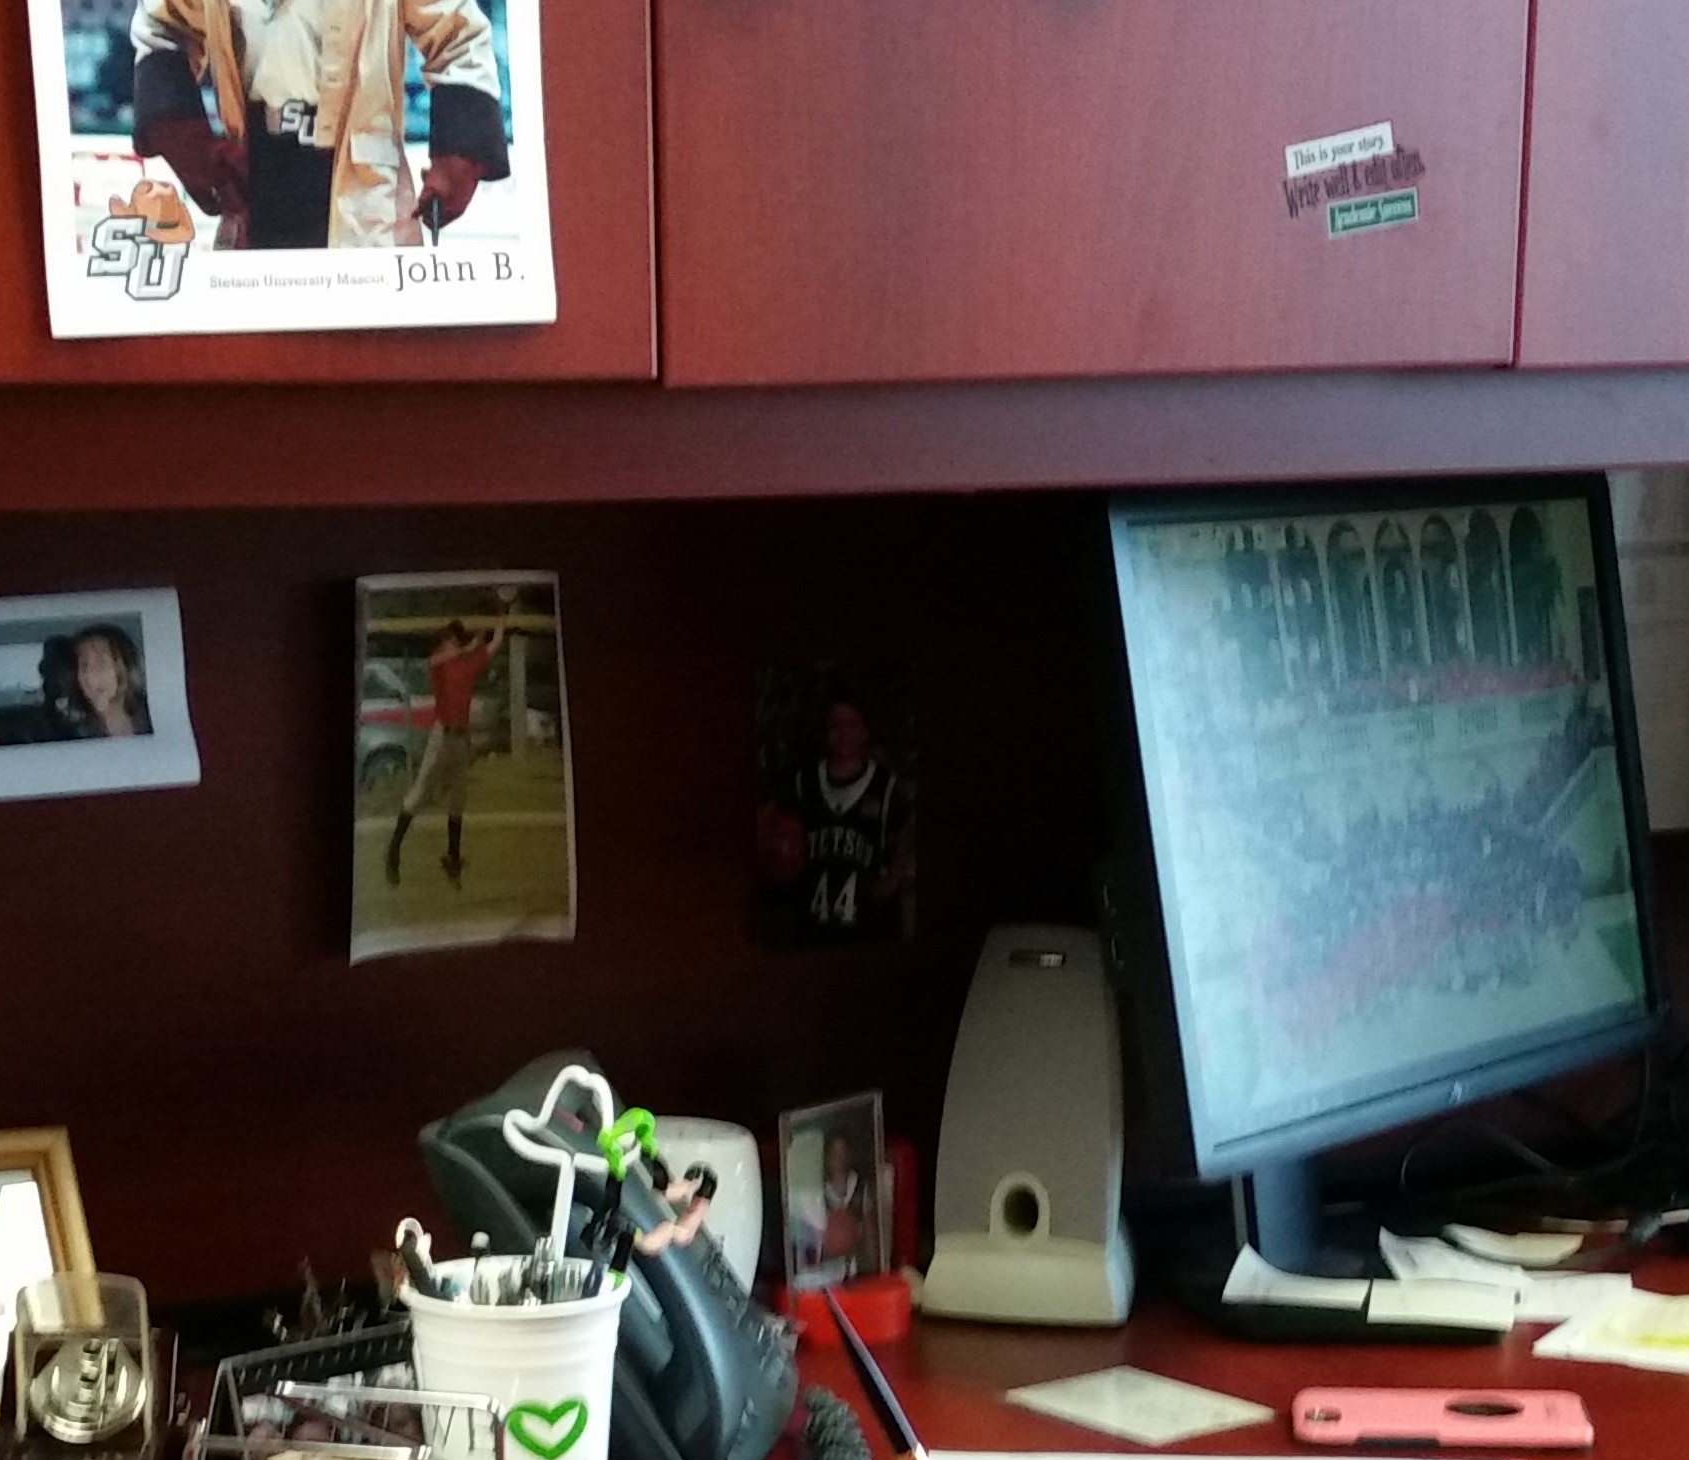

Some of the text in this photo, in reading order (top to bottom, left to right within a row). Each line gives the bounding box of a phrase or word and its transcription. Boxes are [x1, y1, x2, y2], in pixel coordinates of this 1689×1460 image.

[1294, 147, 1316, 170] This
[1319, 144, 1329, 161] is
[1331, 141, 1355, 162] your
[1283, 175, 1320, 218] Write
[1323, 163, 1350, 198] well
[87, 215, 191, 300] SU
[209, 275, 259, 290] Stetson
[263, 273, 332, 290] University
[394, 252, 476, 291] John
[493, 252, 527, 281] B.
[810, 869, 858, 925] 44
